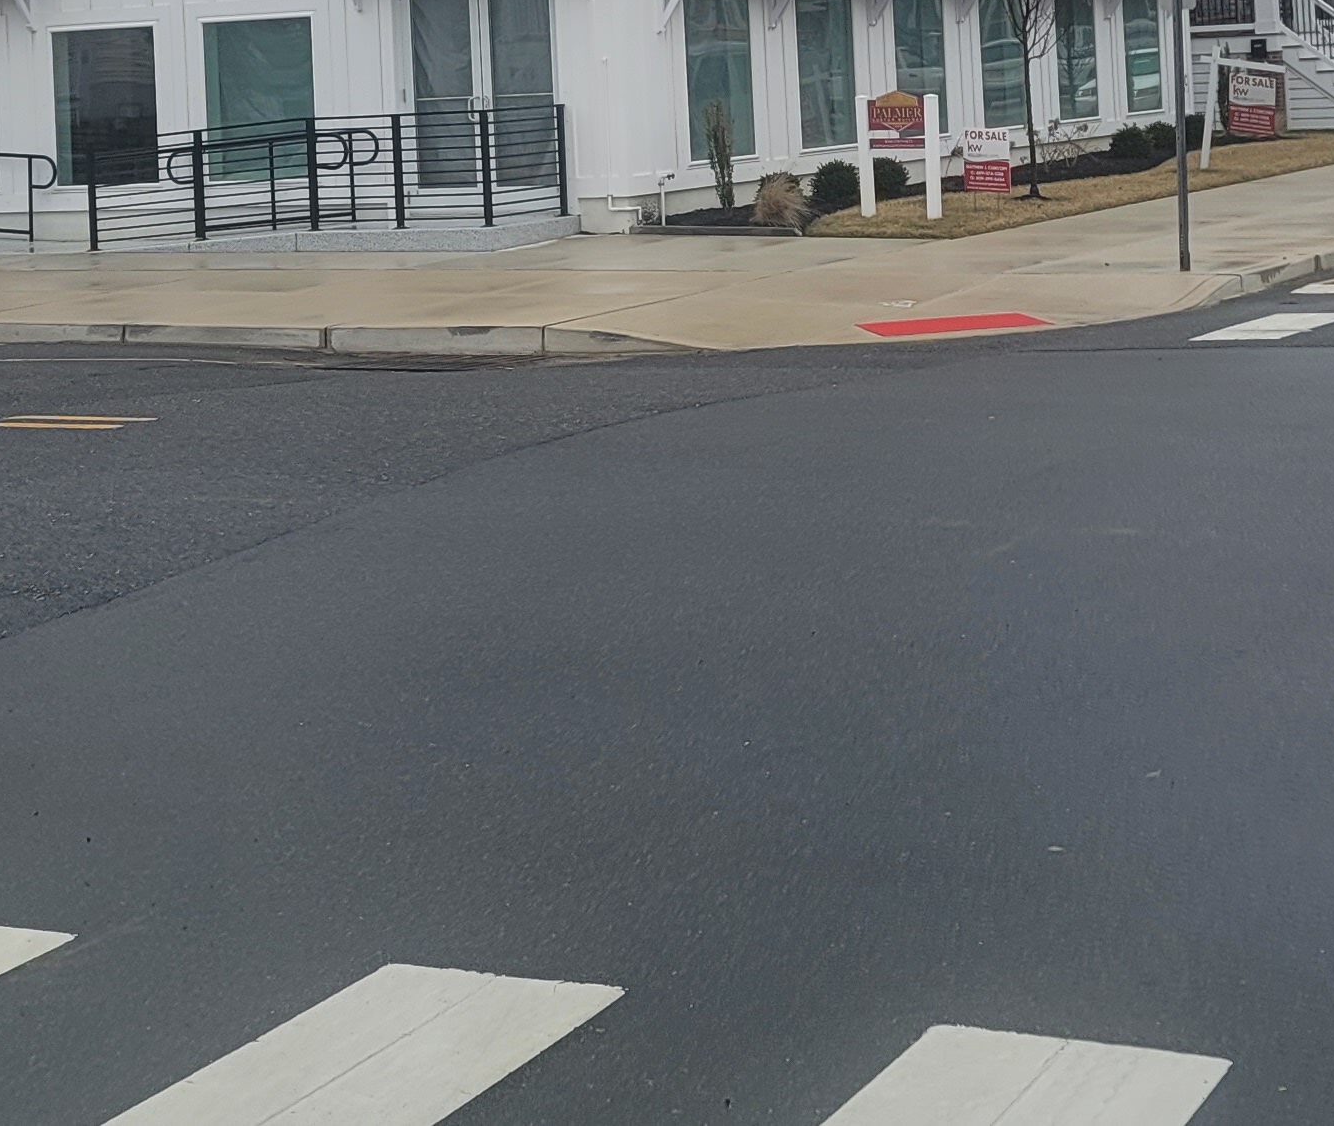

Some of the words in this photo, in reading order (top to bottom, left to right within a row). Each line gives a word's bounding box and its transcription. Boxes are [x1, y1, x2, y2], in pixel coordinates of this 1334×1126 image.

[1231, 75, 1250, 86] FOR
[1252, 78, 1274, 89] SALE
[1233, 85, 1249, 96] kw
[873, 107, 922, 118] PALMER
[965, 130, 983, 140] FOR
[985, 131, 1007, 141] SALE
[967, 141, 983, 152] kw
